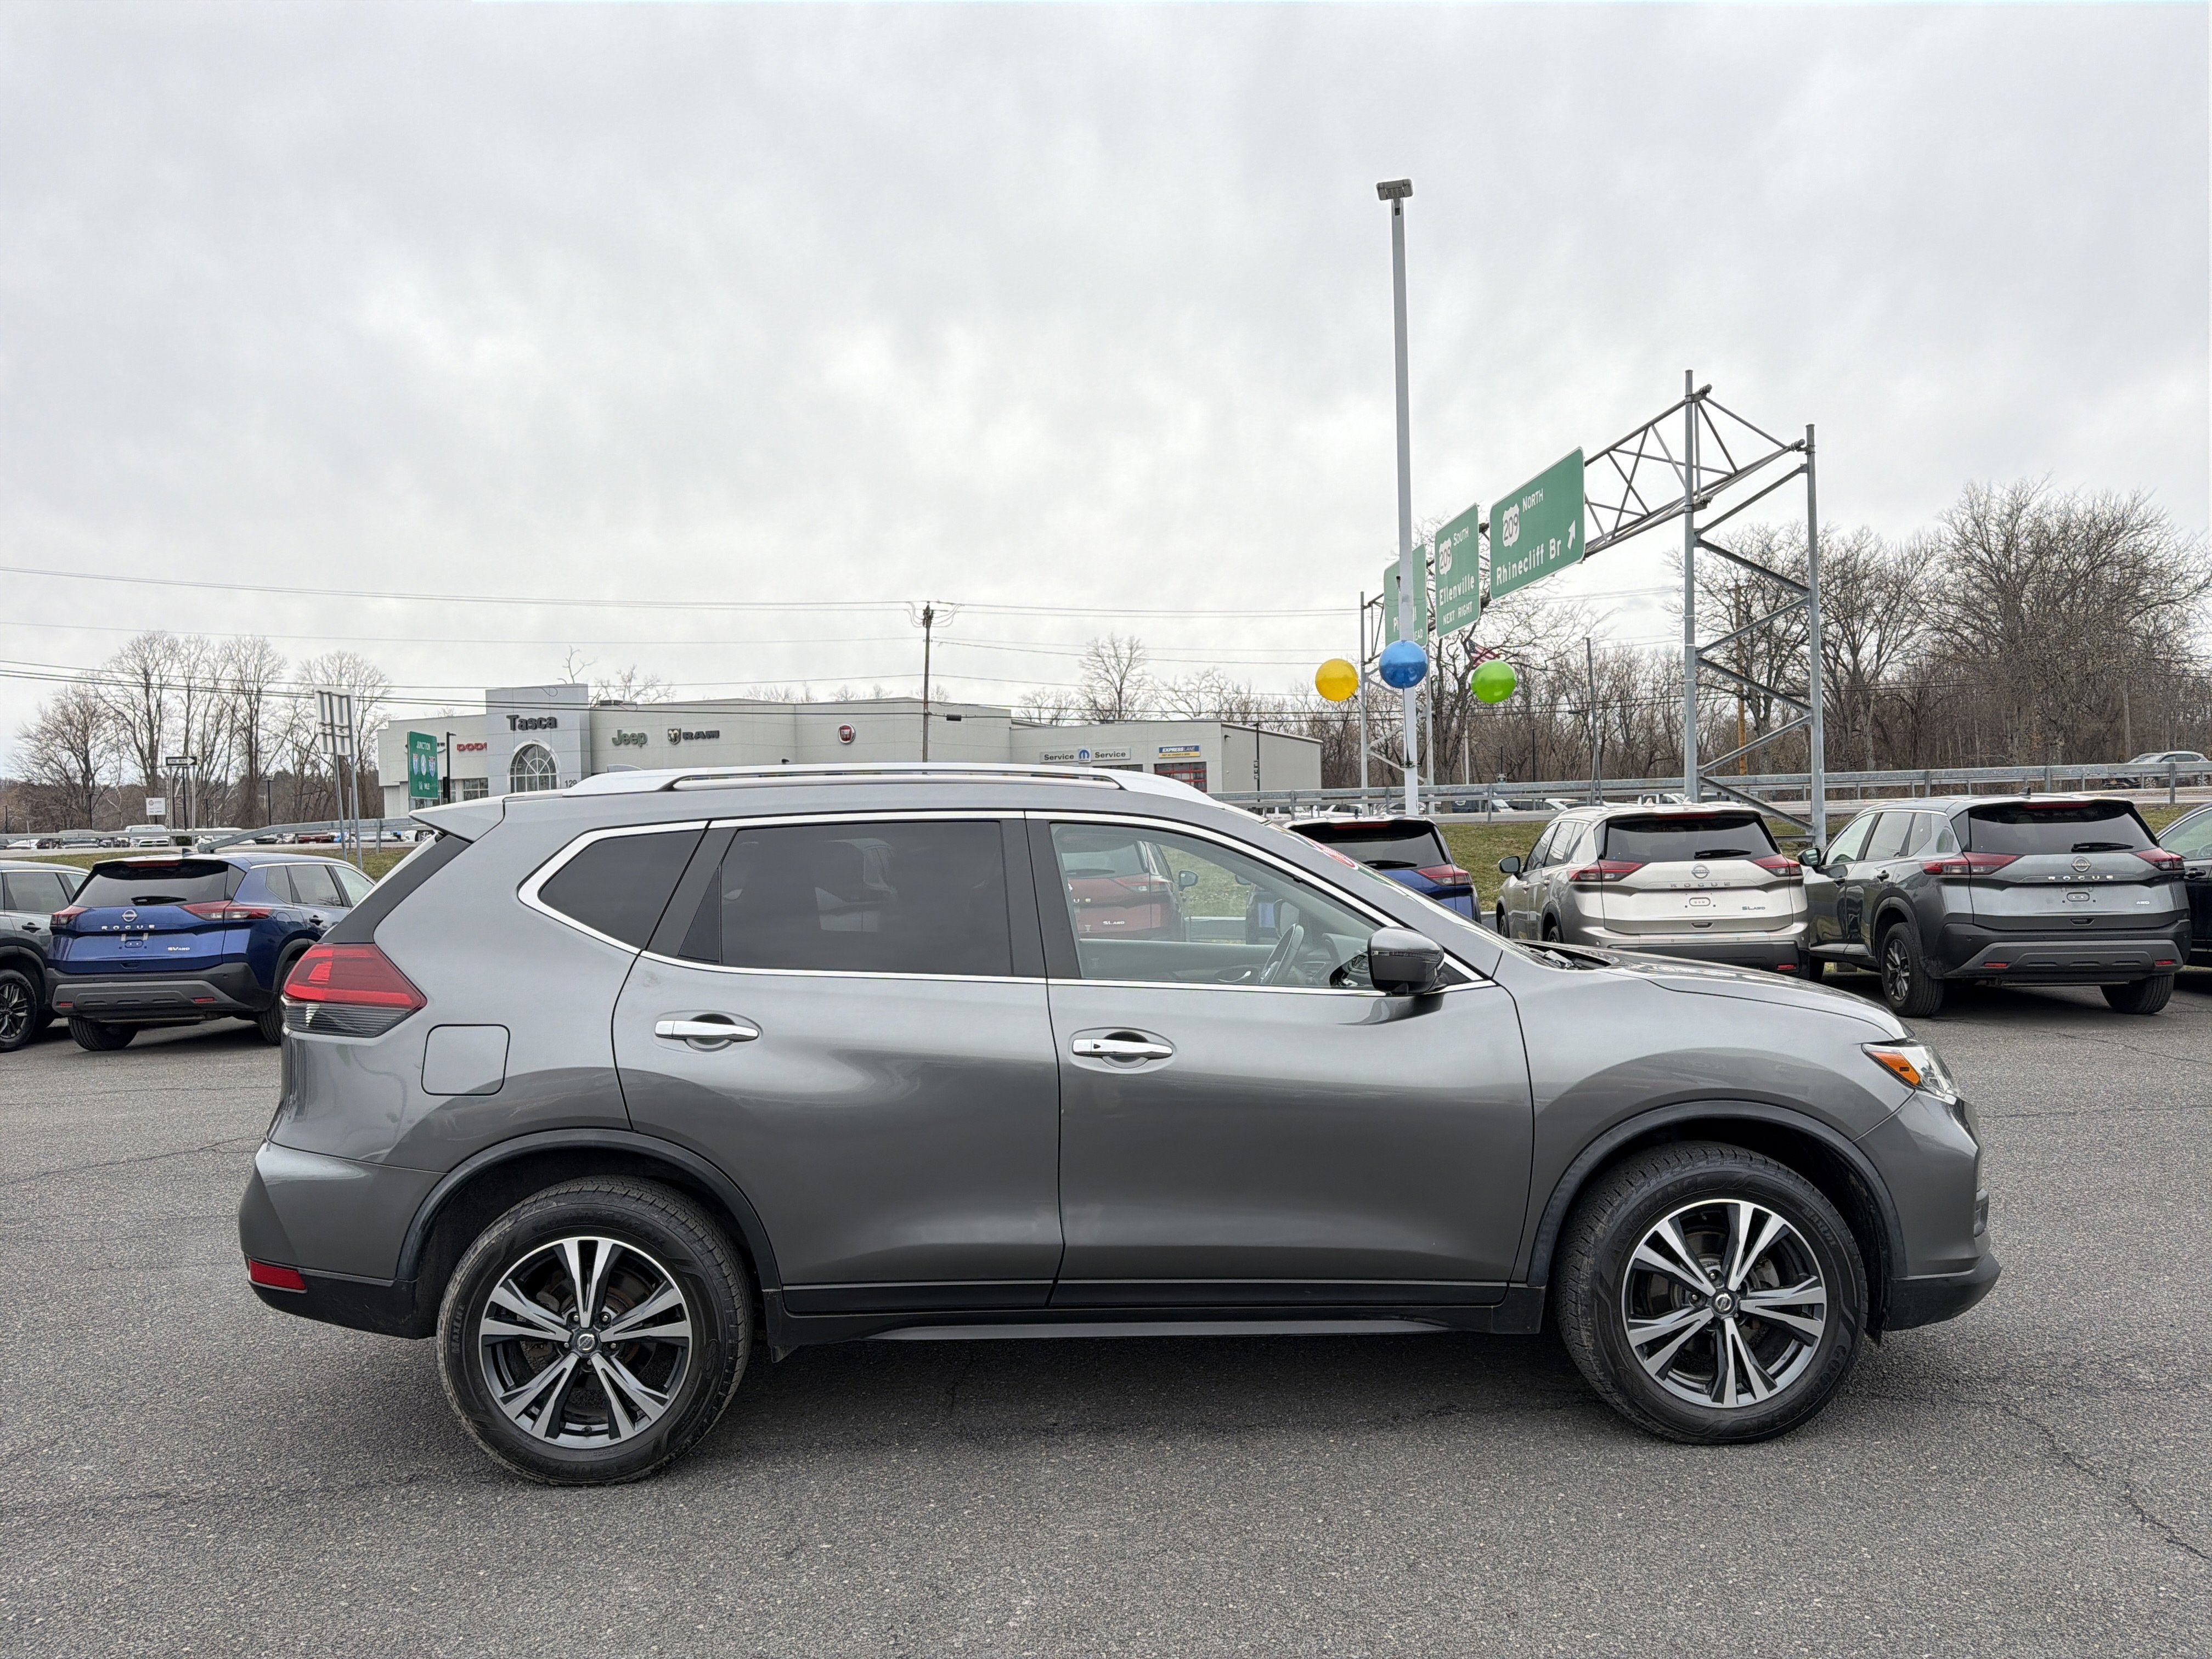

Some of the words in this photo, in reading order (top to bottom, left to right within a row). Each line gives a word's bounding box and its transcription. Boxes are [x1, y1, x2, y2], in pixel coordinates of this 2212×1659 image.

[1522, 488, 1544, 512] NORTH
[1453, 526, 1469, 546] SOUTH
[1504, 514, 1519, 541] 209
[1440, 546, 1451, 569] 209
[1497, 543, 1544, 586] Rhinecliff
[1549, 538, 1561, 560] Br
[1439, 573, 1475, 606] Ellenville
[1443, 610, 1455, 626] NEXT
[1458, 601, 1472, 618] RIGHT
[506, 714, 557, 731] Tasca
[612, 730, 647, 747] Jeep
[682, 730, 720, 740] RAM
[457, 742, 487, 751] DOD
[565, 780, 577, 788] 129
